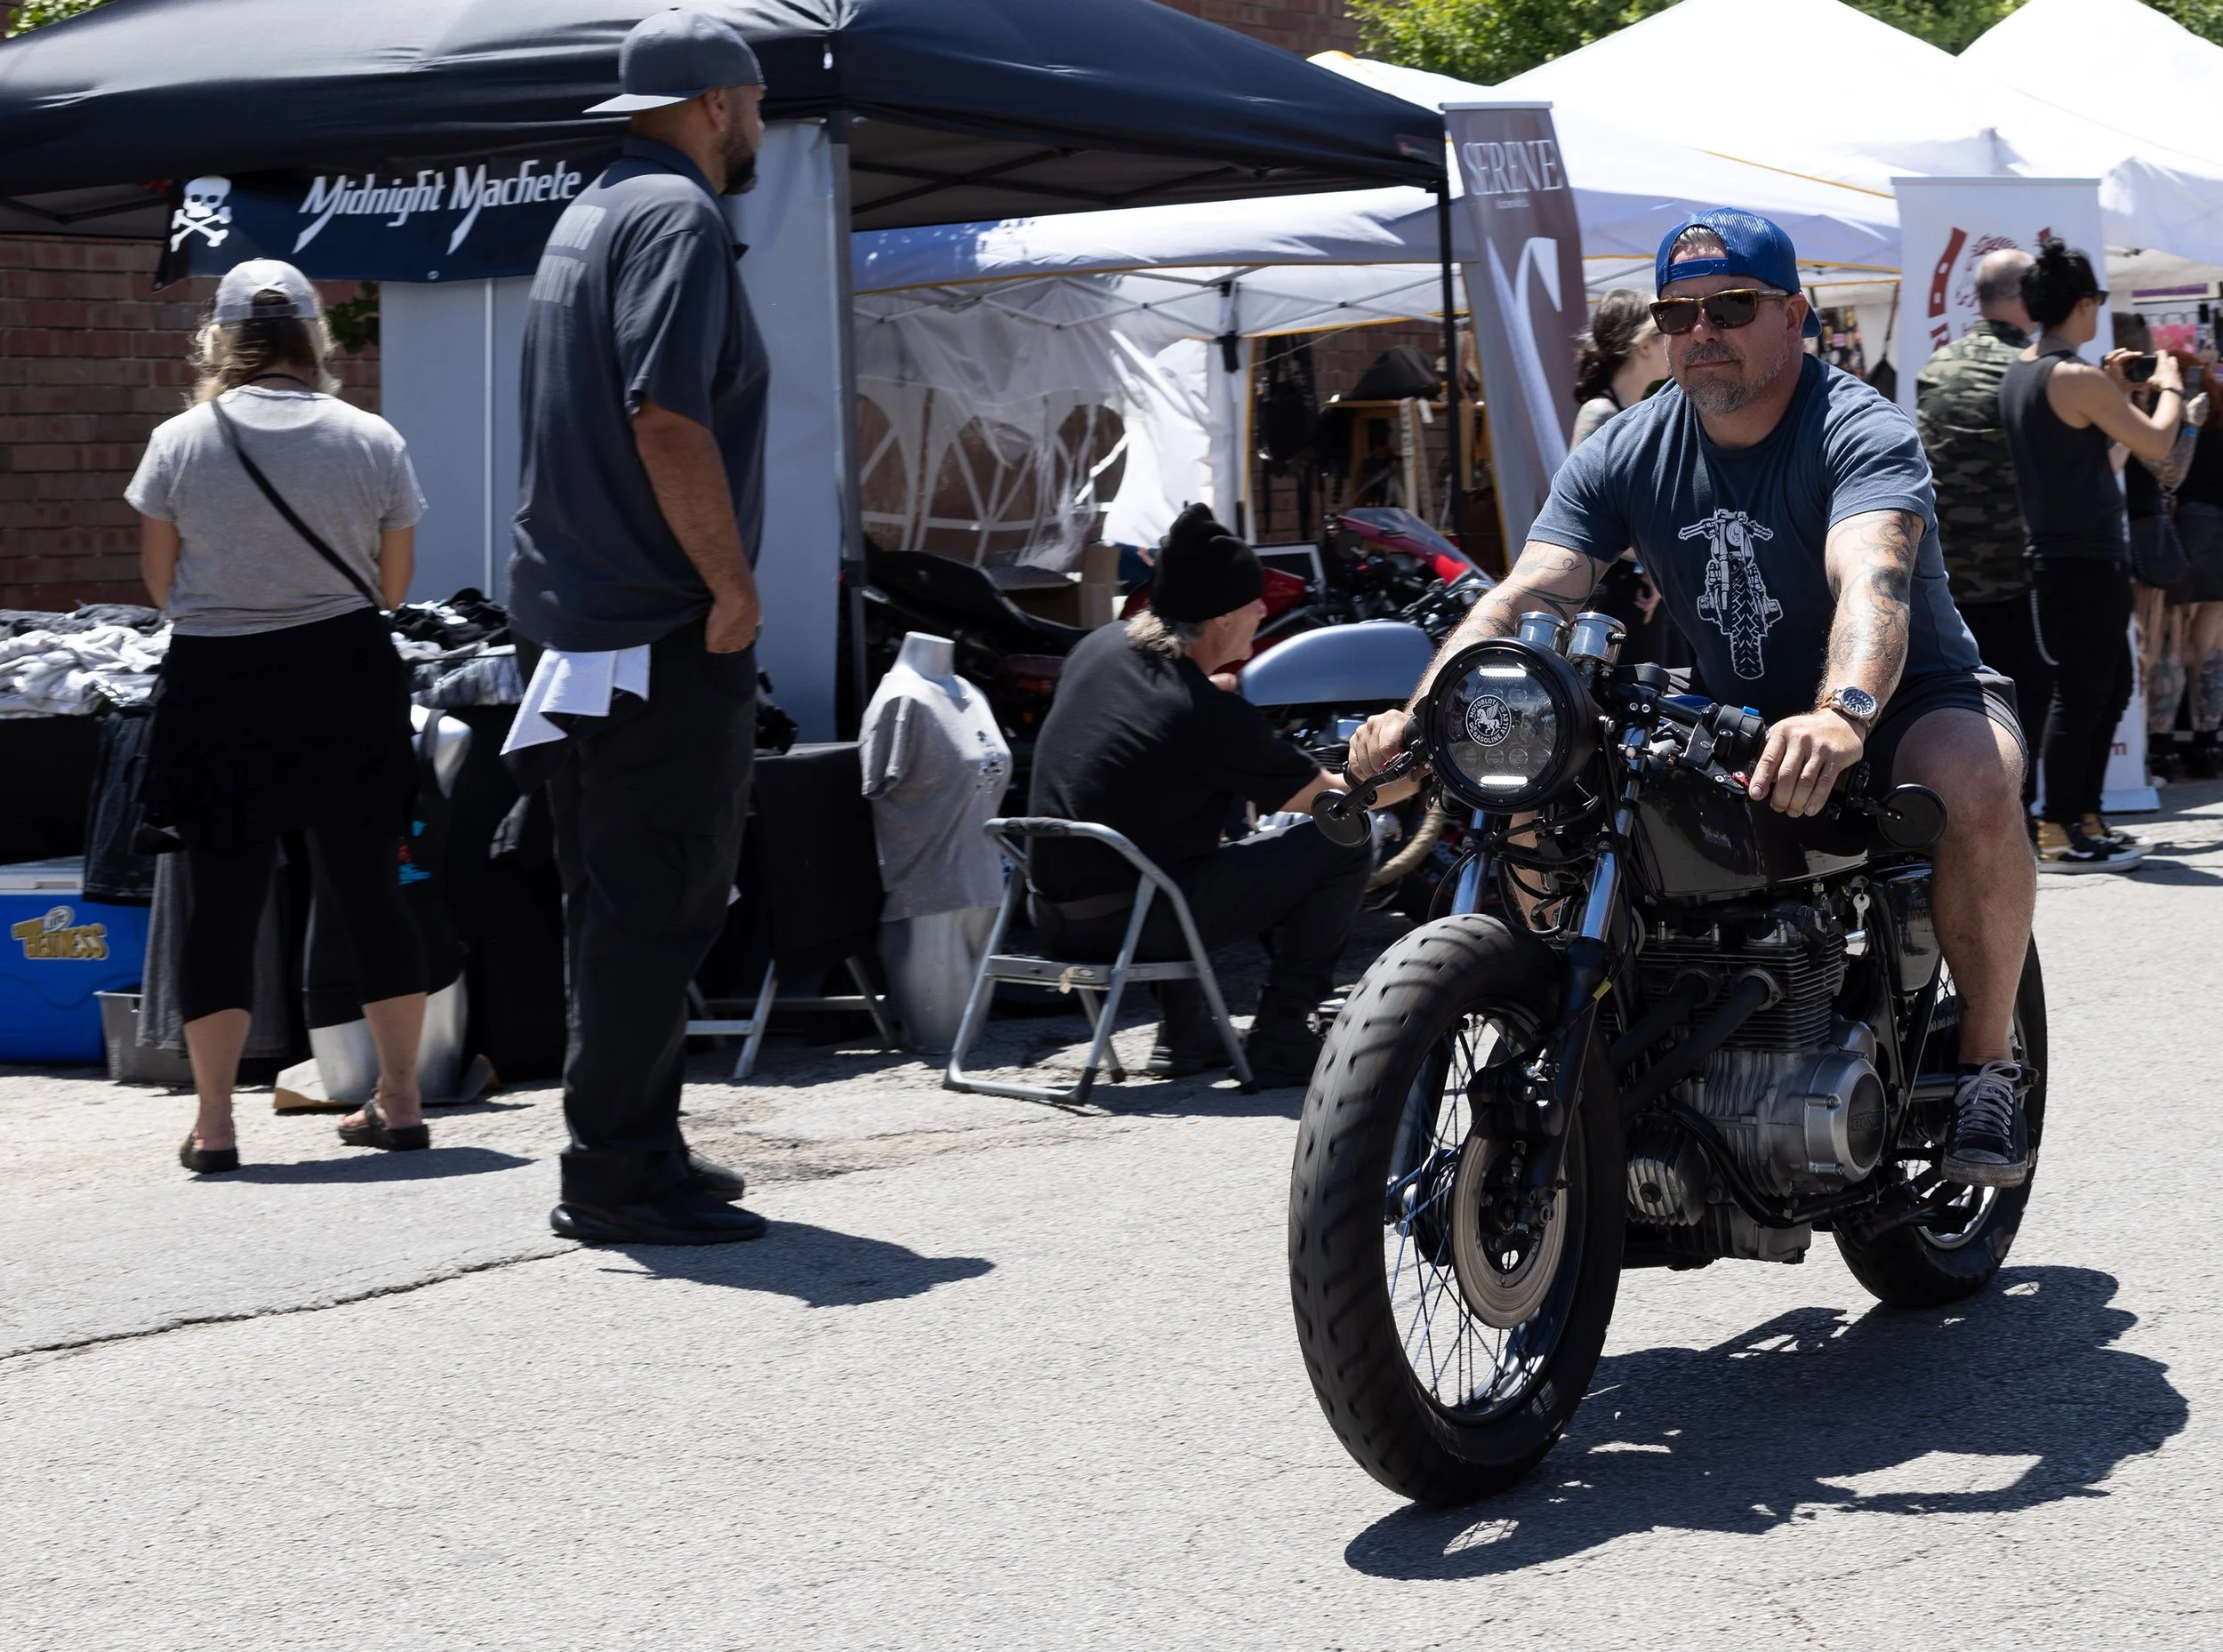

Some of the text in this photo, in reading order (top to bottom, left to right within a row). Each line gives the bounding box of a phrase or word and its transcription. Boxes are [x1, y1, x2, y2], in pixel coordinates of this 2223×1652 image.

[1462, 140, 1563, 196] SERENE
[292, 170, 446, 254] Midnight
[446, 159, 582, 255] Machete
[1469, 698, 1497, 718] MOTOBLOT
[1473, 713, 1509, 743] GASOLINE ALLEY
